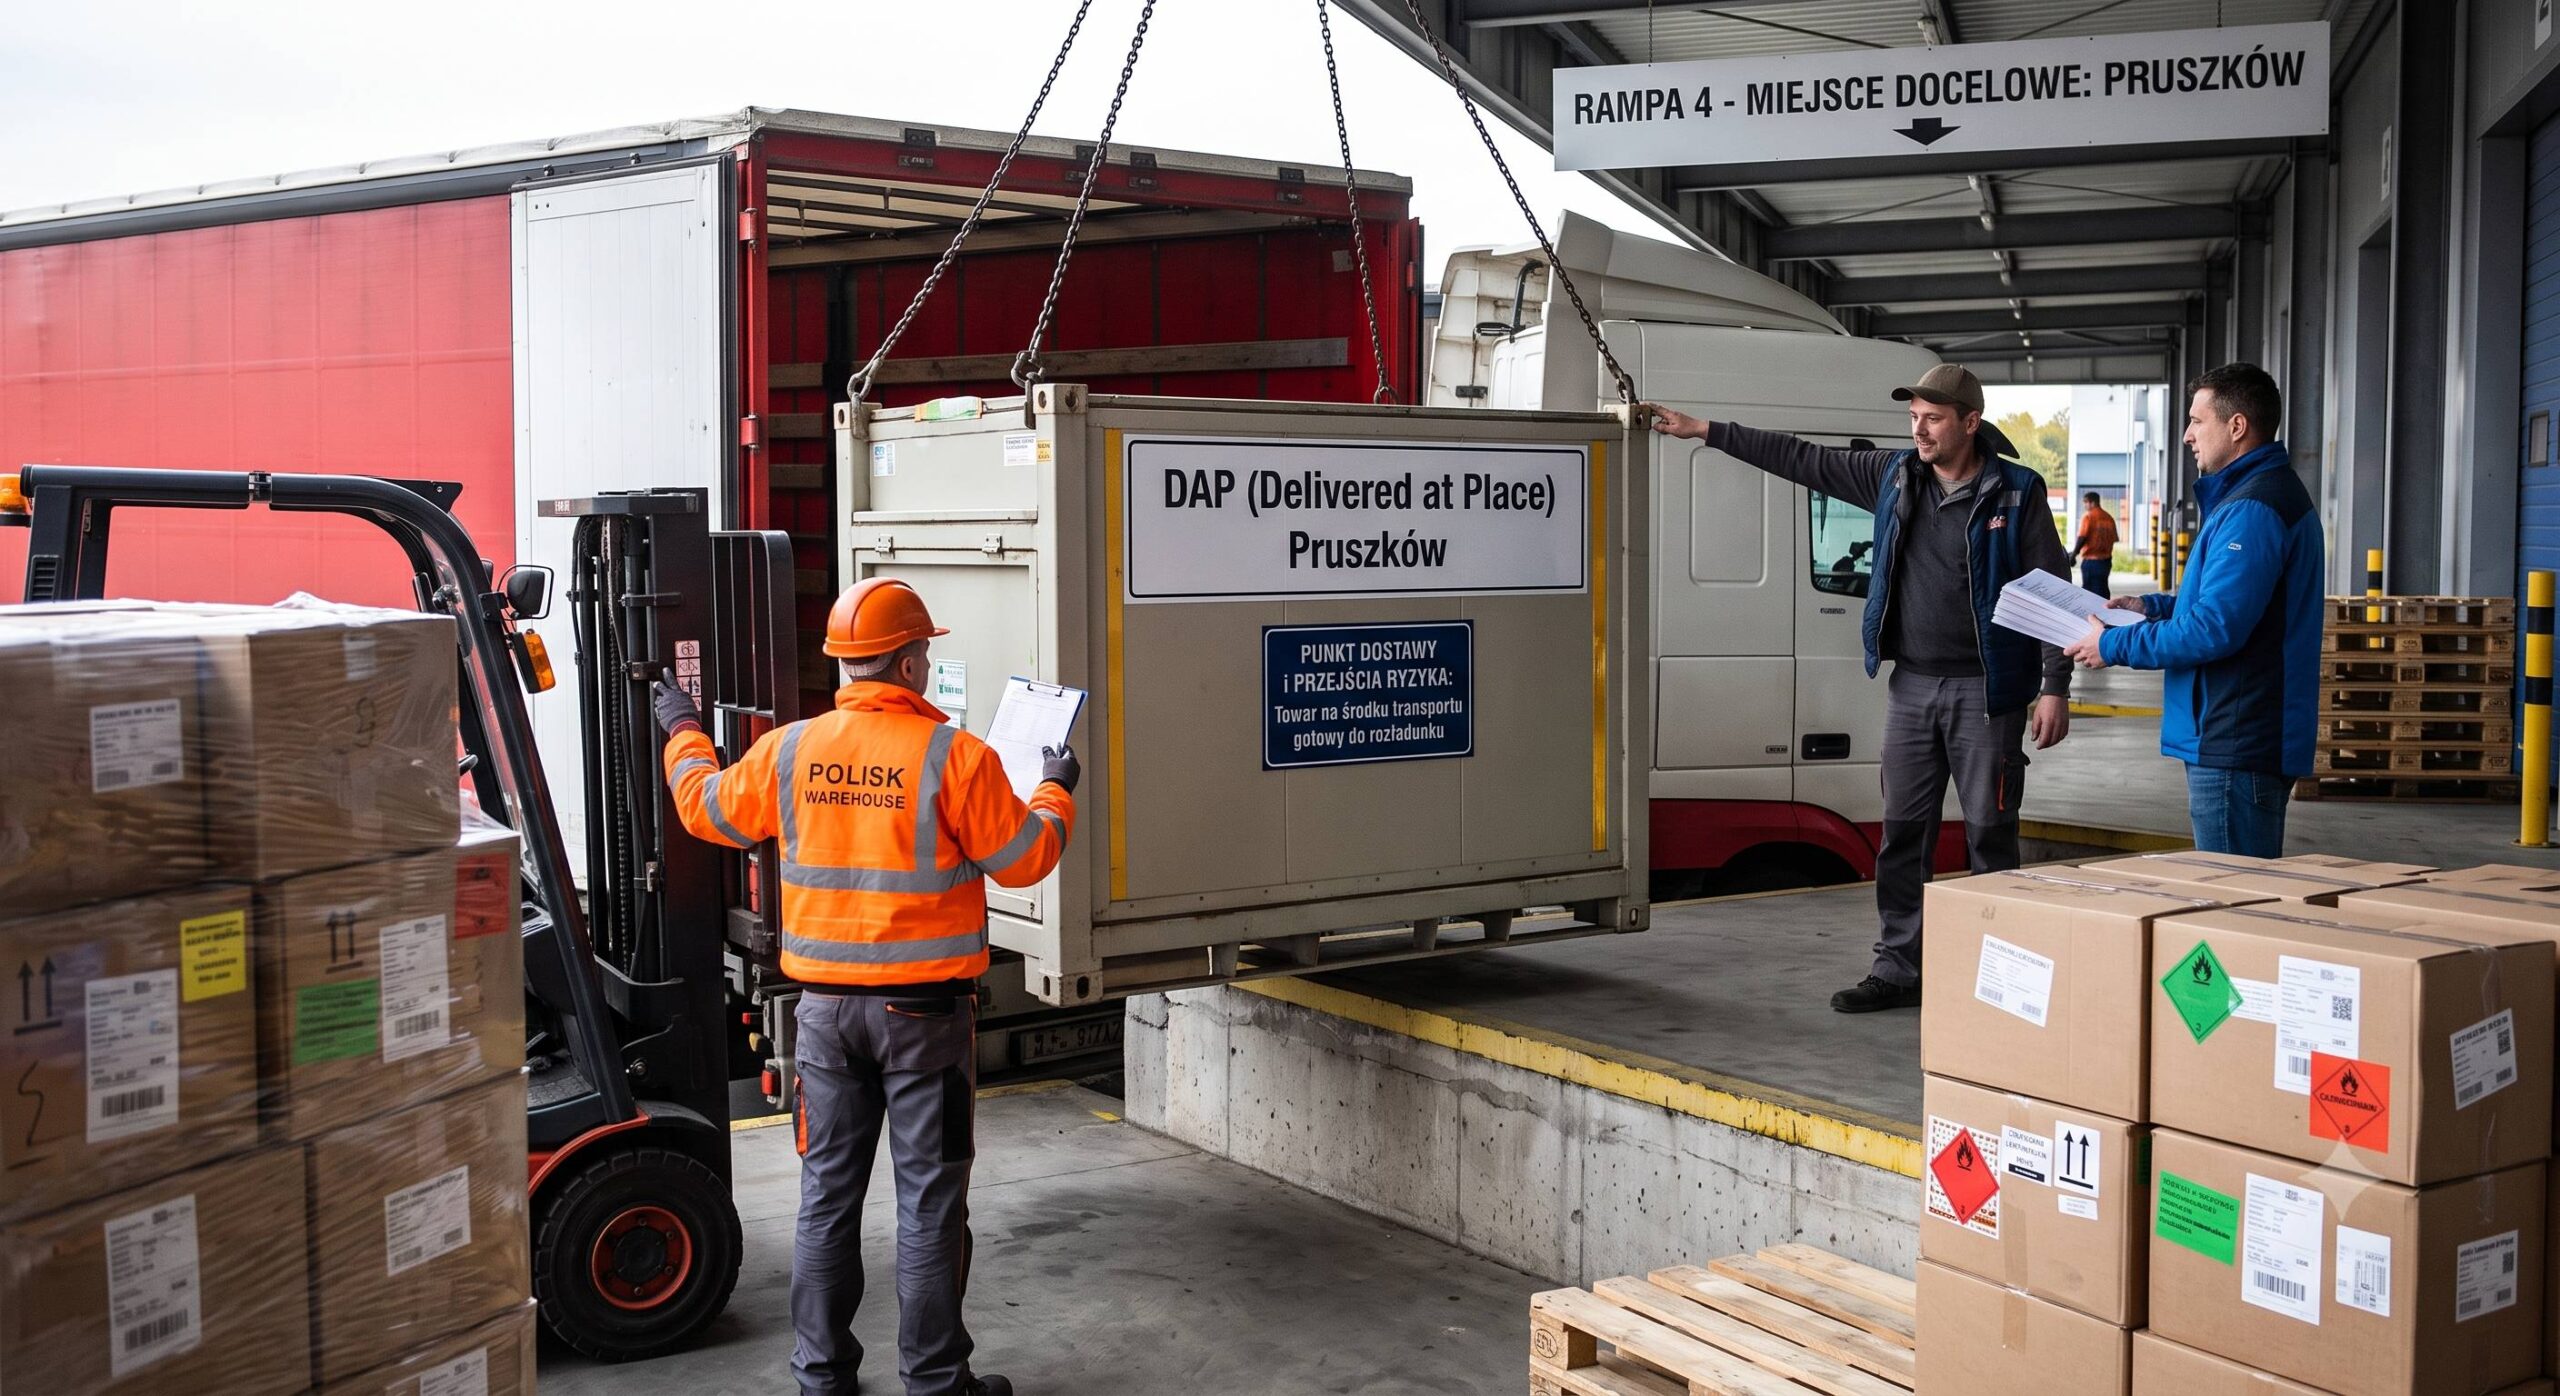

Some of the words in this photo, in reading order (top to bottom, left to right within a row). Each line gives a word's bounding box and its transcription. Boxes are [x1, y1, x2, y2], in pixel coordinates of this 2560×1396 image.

[1574, 87, 1686, 125] RAMPA
[1694, 86, 1713, 118] 4
[1746, 75, 1885, 116] MIEJSCE
[1895, 63, 2092, 108] DOCELOWE:
[2104, 43, 2306, 97] PRUSZKÓW
[1164, 468, 1236, 509] DAP
[1247, 470, 1412, 518] (Delivered
[1422, 473, 1454, 510] at
[1463, 473, 1556, 519] Place)
[1289, 528, 1448, 569] Pruszków
[1301, 642, 1356, 664] PUNKT
[1360, 639, 1438, 662] DOSTAWY
[1284, 674, 1289, 694] i
[1294, 666, 1383, 693] PRZEJŚCIA
[1386, 667, 1454, 689] RYZYKA:
[1274, 705, 1318, 724] Towar
[1321, 706, 1338, 721] na
[1342, 700, 1389, 720] środku
[1392, 697, 1463, 719] transportu
[1293, 726, 1345, 752] gotowy
[1348, 726, 1366, 745] do
[1369, 722, 1445, 744] rozładunku
[809, 763, 905, 789] POLISK
[804, 790, 906, 810] WAREHOUSE
